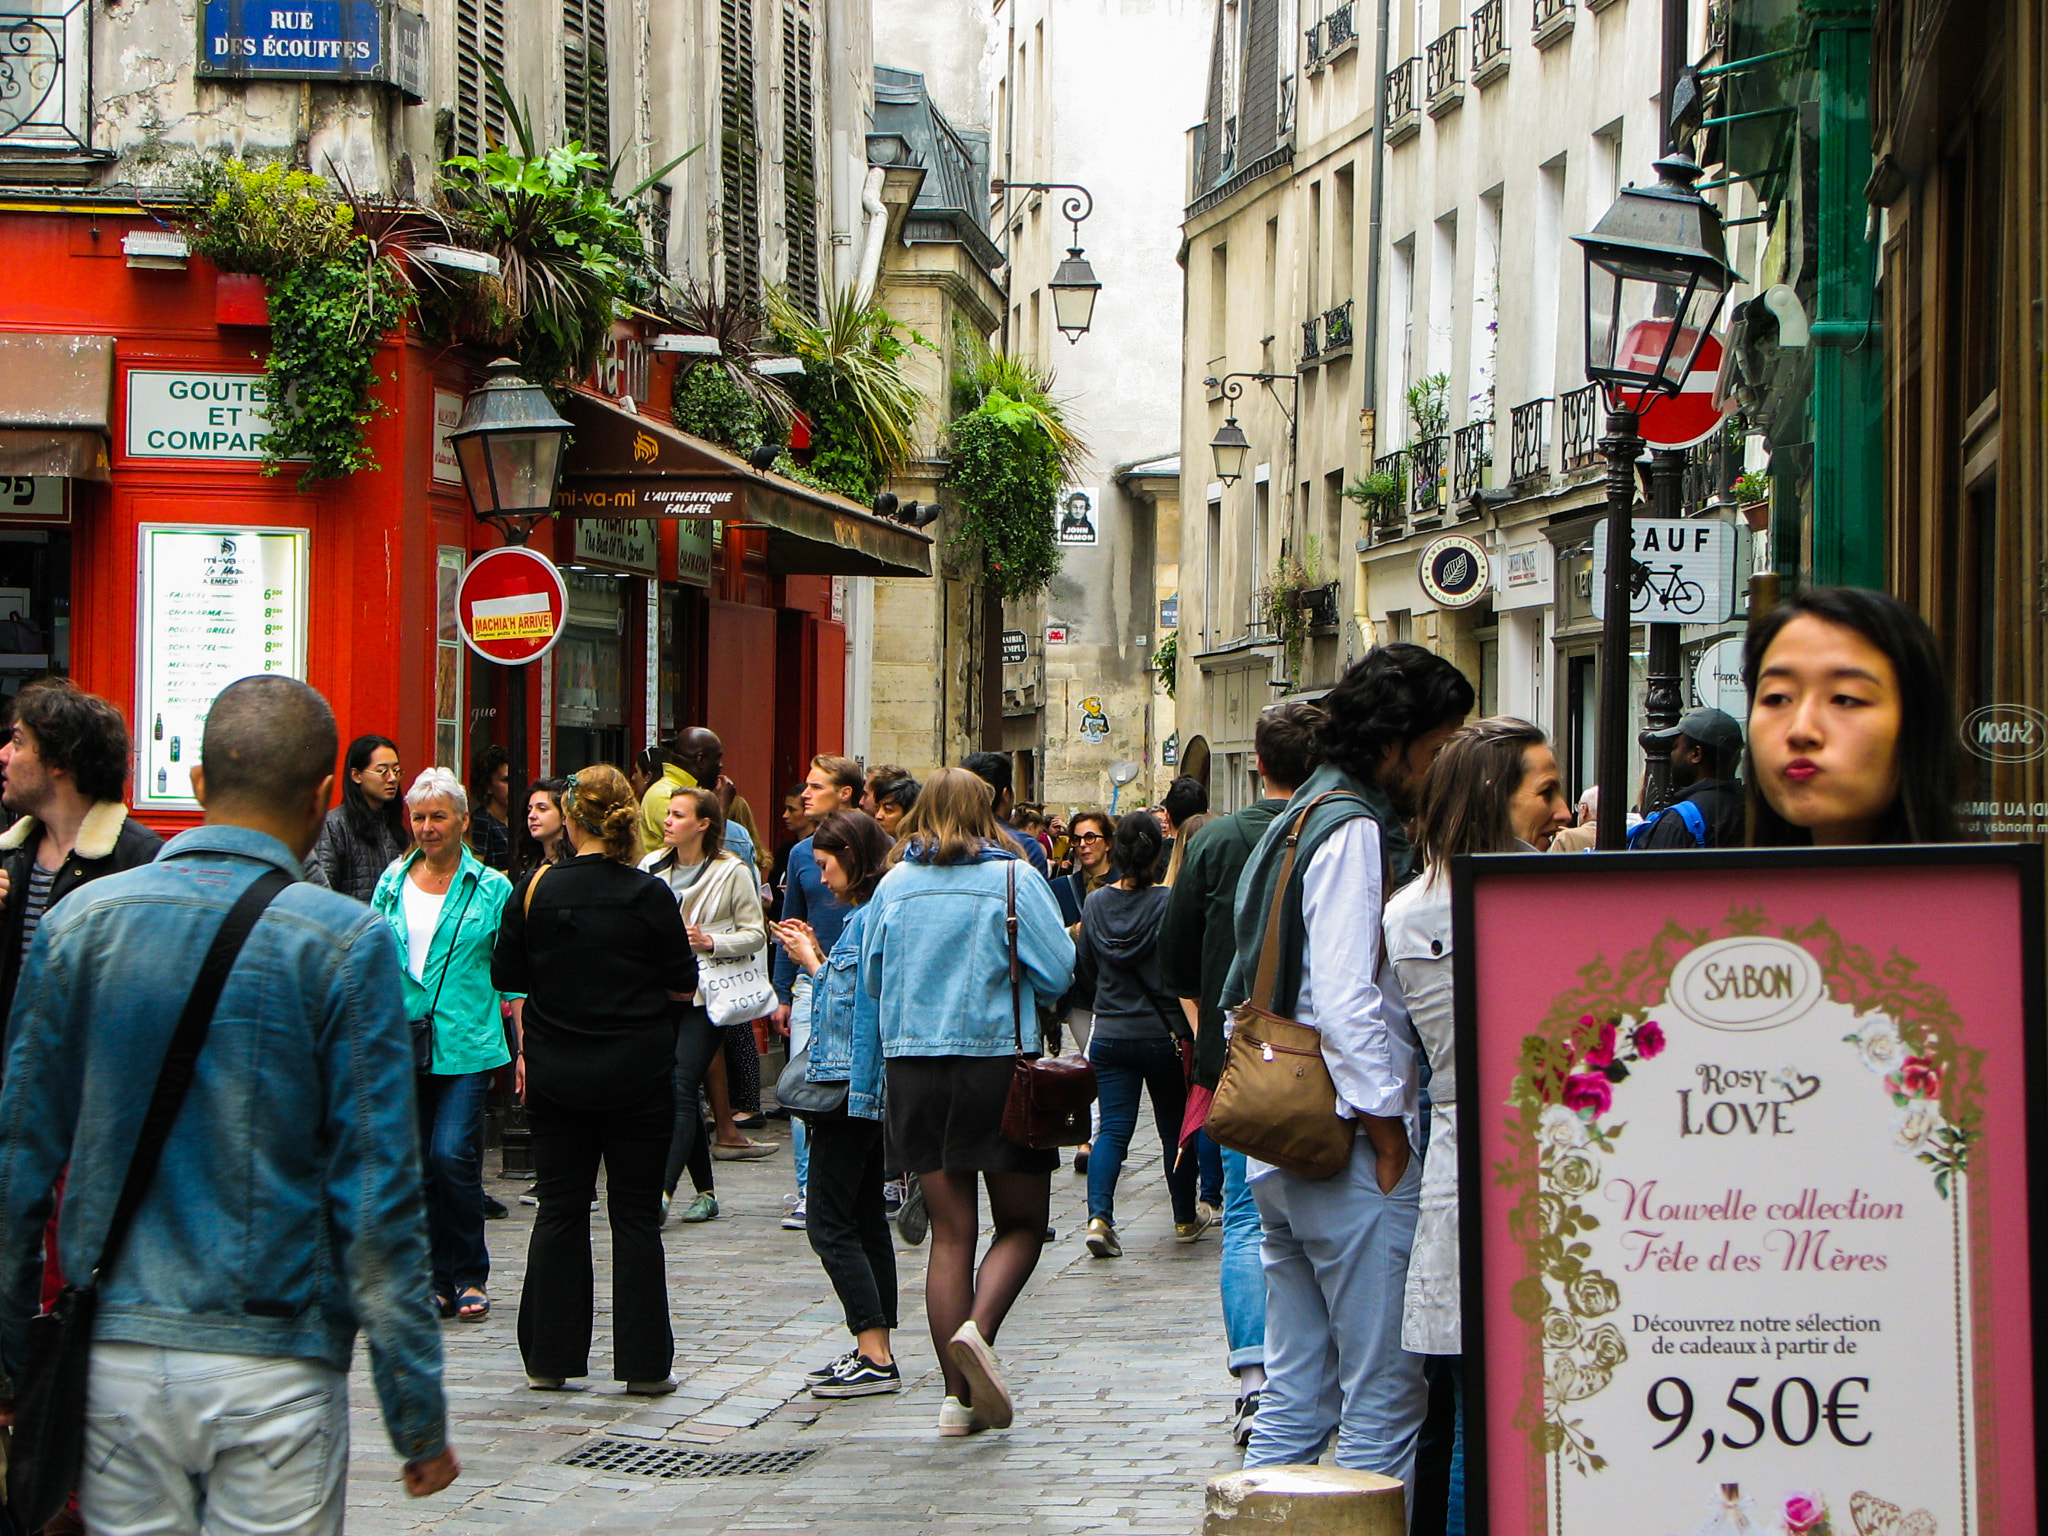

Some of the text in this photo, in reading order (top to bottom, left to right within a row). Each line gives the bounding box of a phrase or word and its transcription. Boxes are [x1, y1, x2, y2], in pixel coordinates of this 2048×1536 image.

[270, 11, 314, 30] RUE
[214, 35, 371, 59] DES ÉCOUFFES
[208, 407, 242, 426] ET
[147, 430, 269, 451] COMPAR
[556, 489, 733, 507] mi-va-mi L'AUTHENTIQUE
[664, 504, 712, 514] FALAFEL
[1062, 533, 1094, 541] HAMON
[1066, 526, 1089, 534] JOHN
[1433, 590, 1458, 604] SINCE
[518, 614, 552, 629] ARRIVE!
[1713, 664, 1739, 686] Happy
[1705, 963, 1792, 1001] SABON
[729, 991, 766, 1011] TOTE
[1603, 1178, 1905, 1221] Nouvelle collection
[1620, 1229, 1889, 1272] Fête des Mères
[1633, 1313, 1882, 1333] Découvrez notre sélection
[1651, 1336, 1858, 1361] de cadeaux à partir de
[1646, 1376, 1873, 1464] 9,50€
